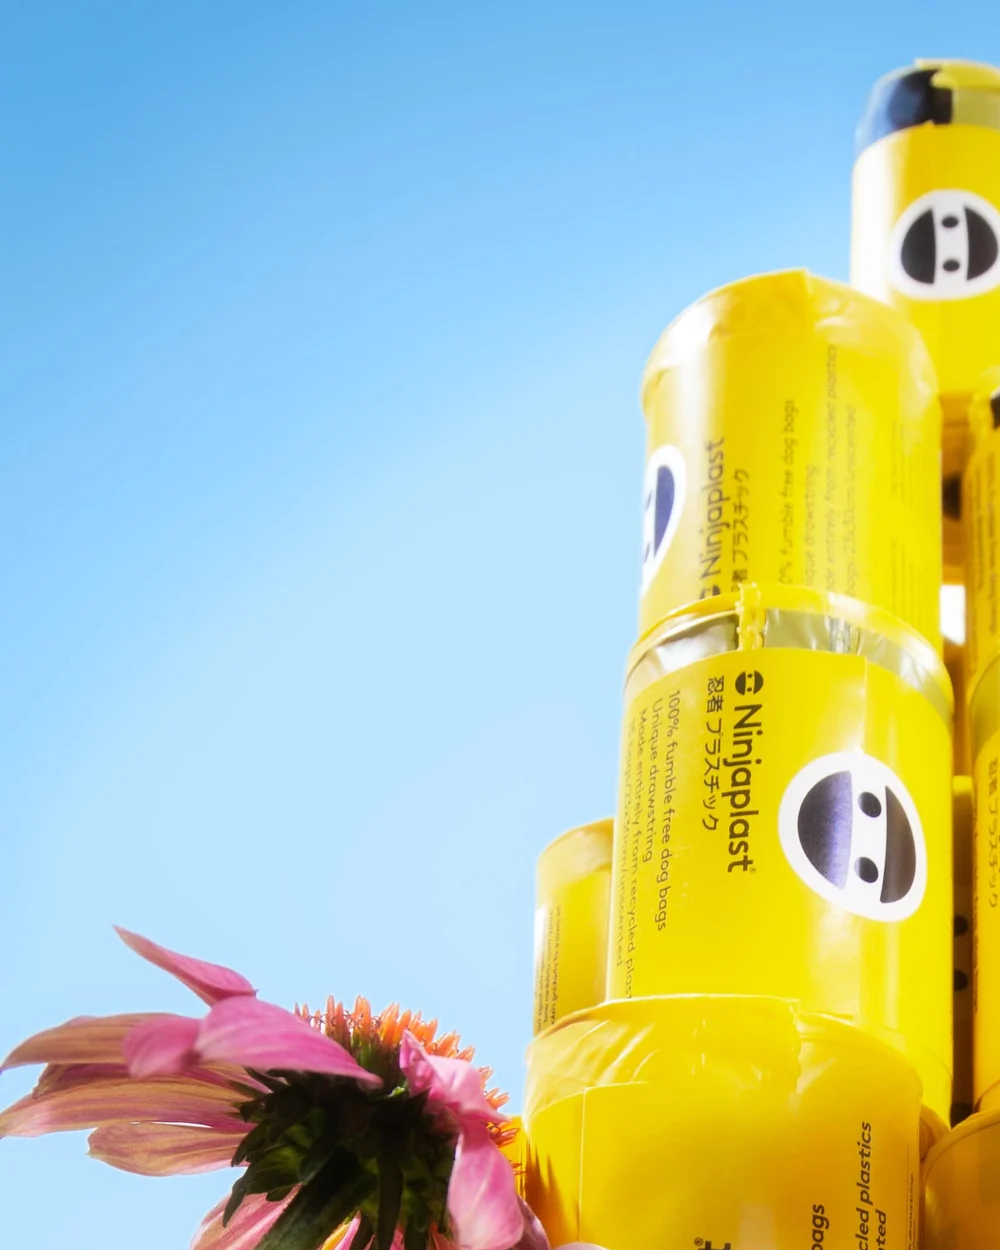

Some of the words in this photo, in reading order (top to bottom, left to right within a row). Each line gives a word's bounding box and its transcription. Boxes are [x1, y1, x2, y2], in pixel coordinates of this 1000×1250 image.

[667, 690, 681, 737] 100%
[706, 675, 724, 714] 忍者
[650, 698, 664, 760] Unique
[664, 741, 679, 804] fumble
[643, 765, 660, 863] drawstring
[661, 809, 675, 844] free
[657, 848, 673, 883] dog
[654, 886, 672, 931] bags
[857, 1121, 873, 1204] plastics
